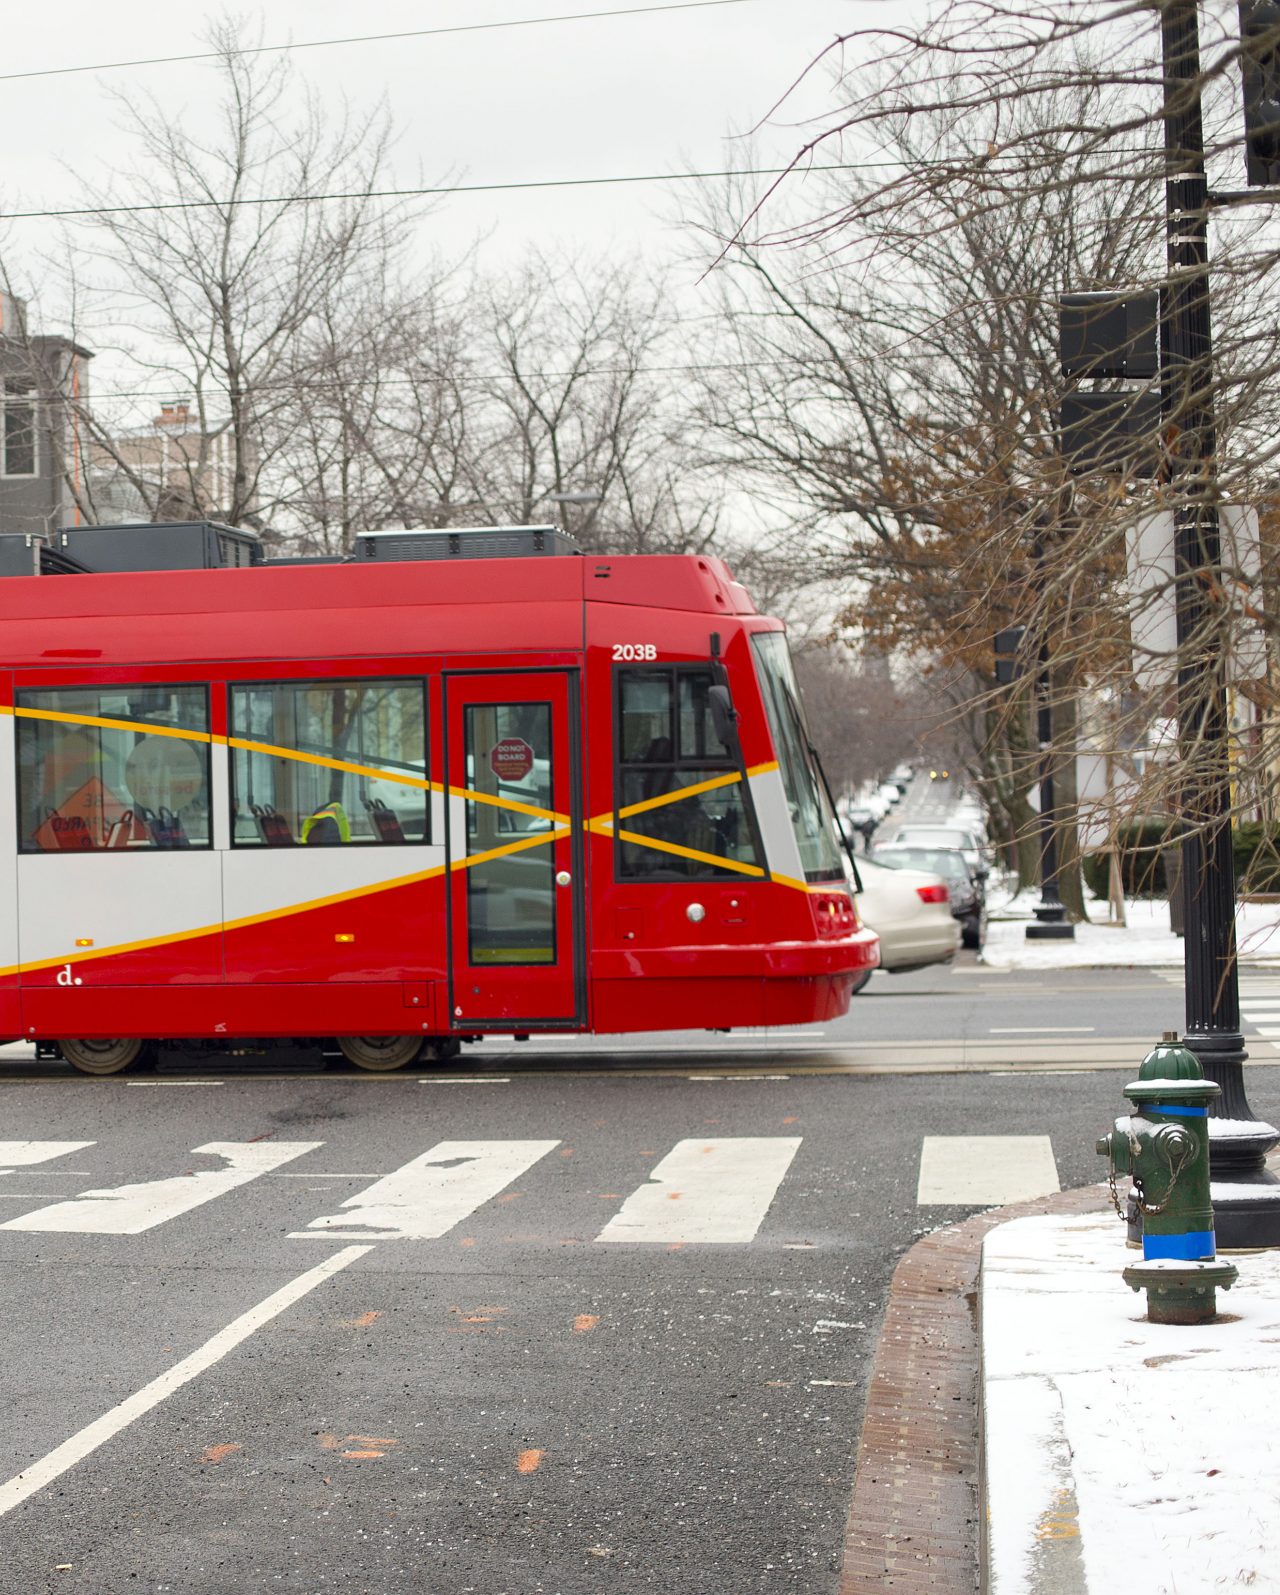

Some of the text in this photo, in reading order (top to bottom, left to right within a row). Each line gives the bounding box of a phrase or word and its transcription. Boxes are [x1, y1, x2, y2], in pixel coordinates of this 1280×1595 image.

[612, 644, 657, 660] 203B
[497, 753, 526, 761] BOARD
[57, 963, 83, 986] d.
